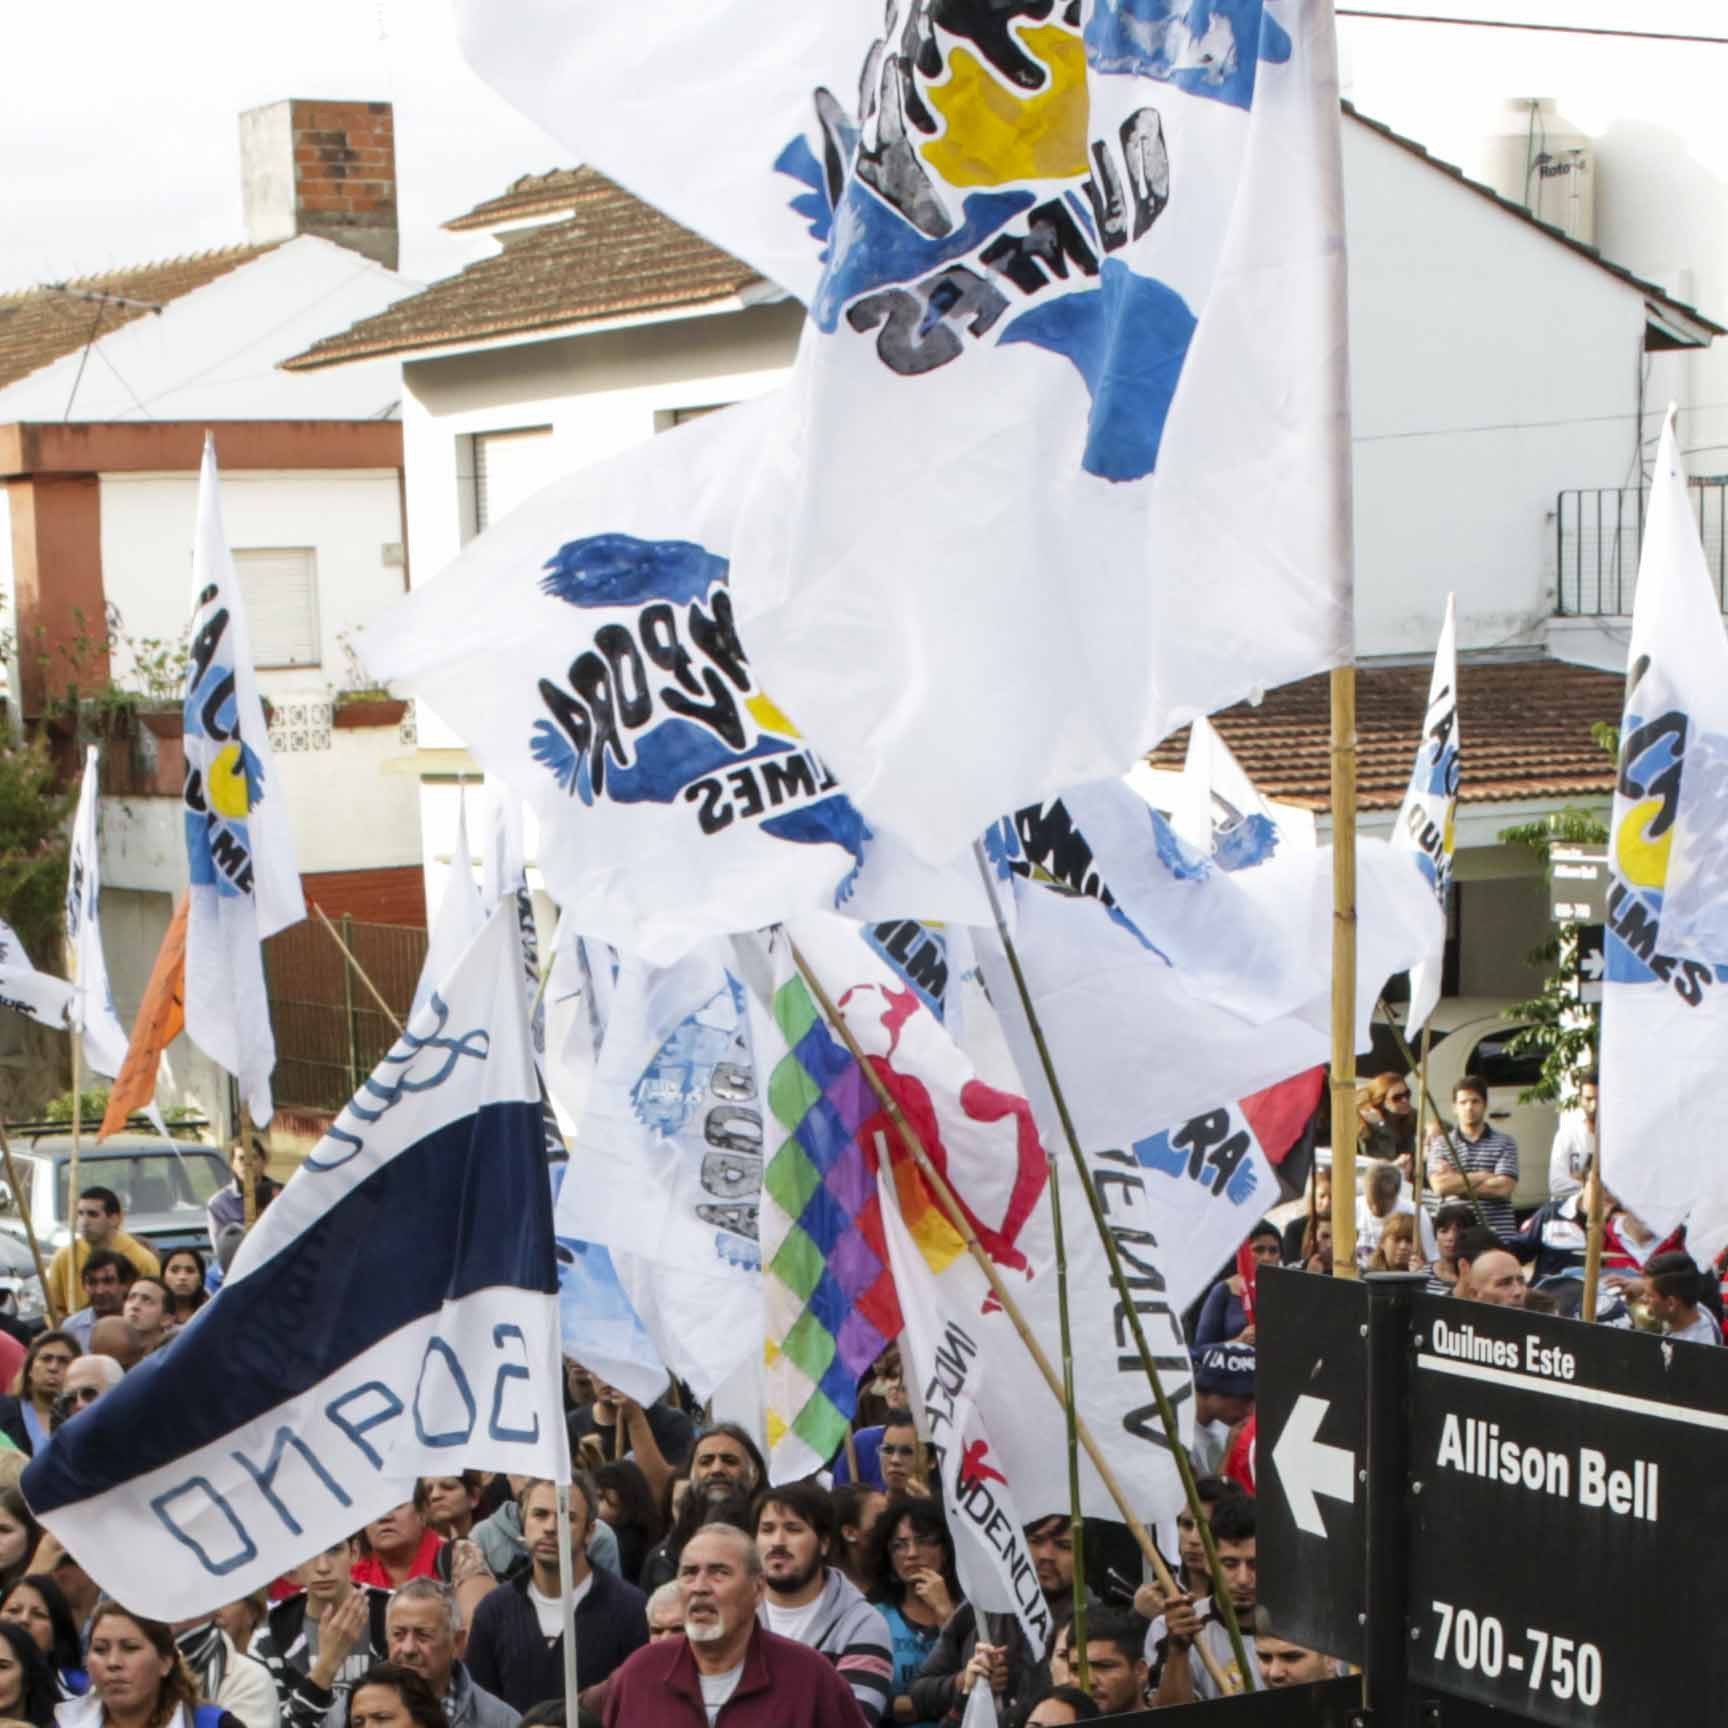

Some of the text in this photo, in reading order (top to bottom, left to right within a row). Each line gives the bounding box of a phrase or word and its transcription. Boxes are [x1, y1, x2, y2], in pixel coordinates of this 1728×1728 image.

[1433, 1320, 1576, 1380] Quilmes Este
[1436, 1413, 1659, 1522] Allison Bell
[1432, 1601, 1603, 1709] 700-750
